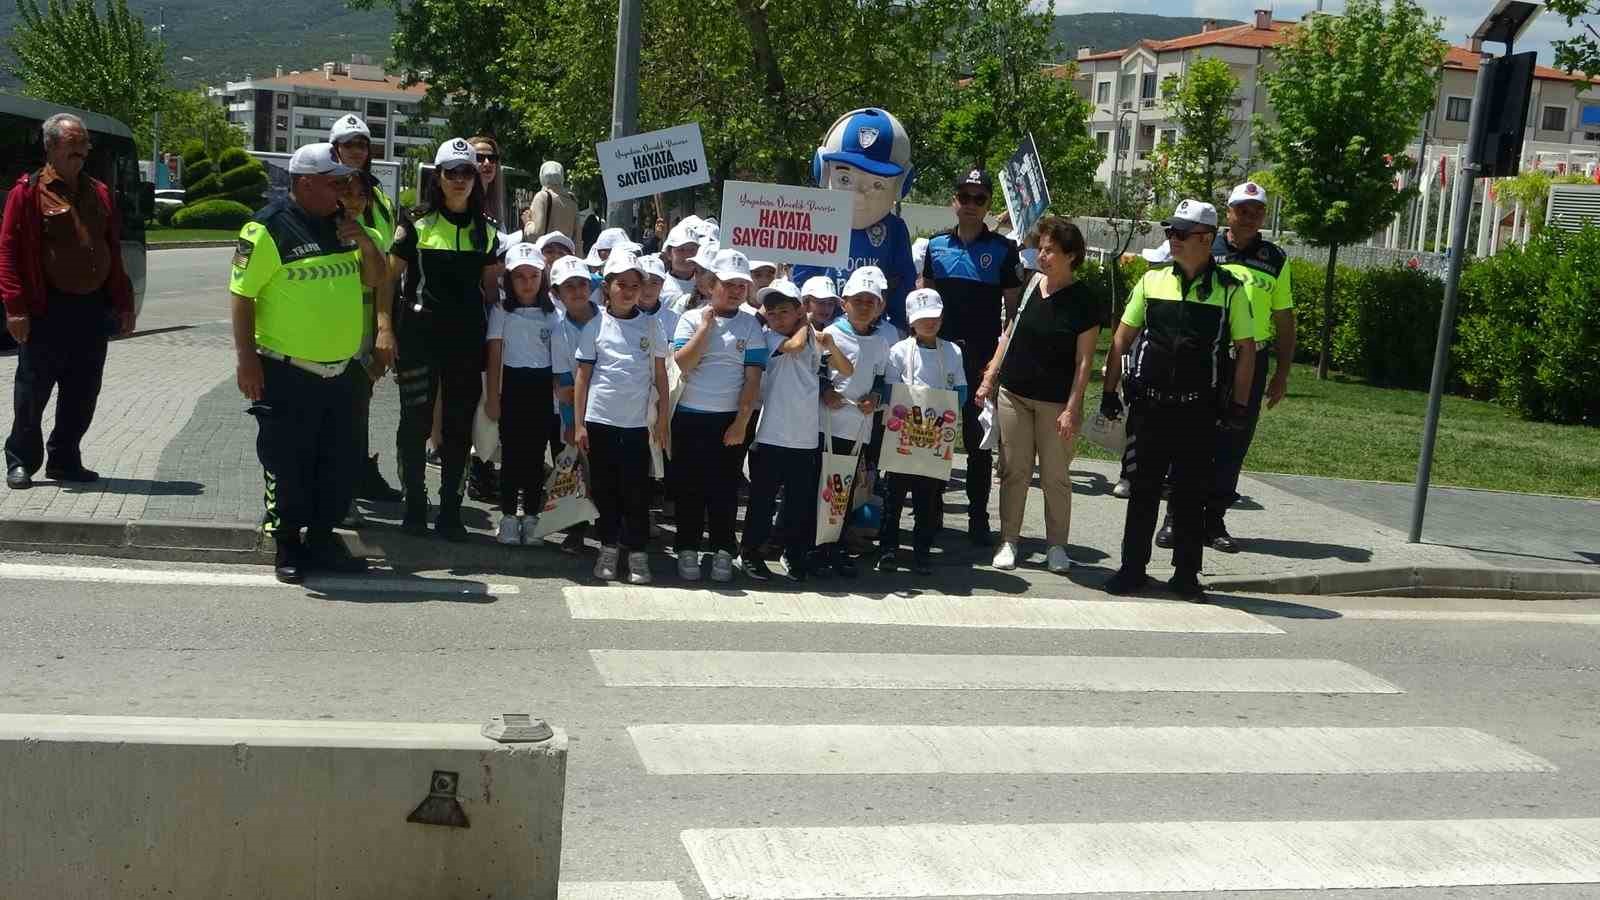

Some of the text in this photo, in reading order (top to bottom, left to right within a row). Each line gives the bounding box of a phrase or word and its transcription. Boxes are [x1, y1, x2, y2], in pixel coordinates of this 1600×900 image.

[632, 150, 675, 170] HAYATA
[617, 158, 698, 188] SAYGI DURUŞU
[759, 208, 812, 231] HAYATA
[732, 227, 838, 255] SAYGI DURUŞU
